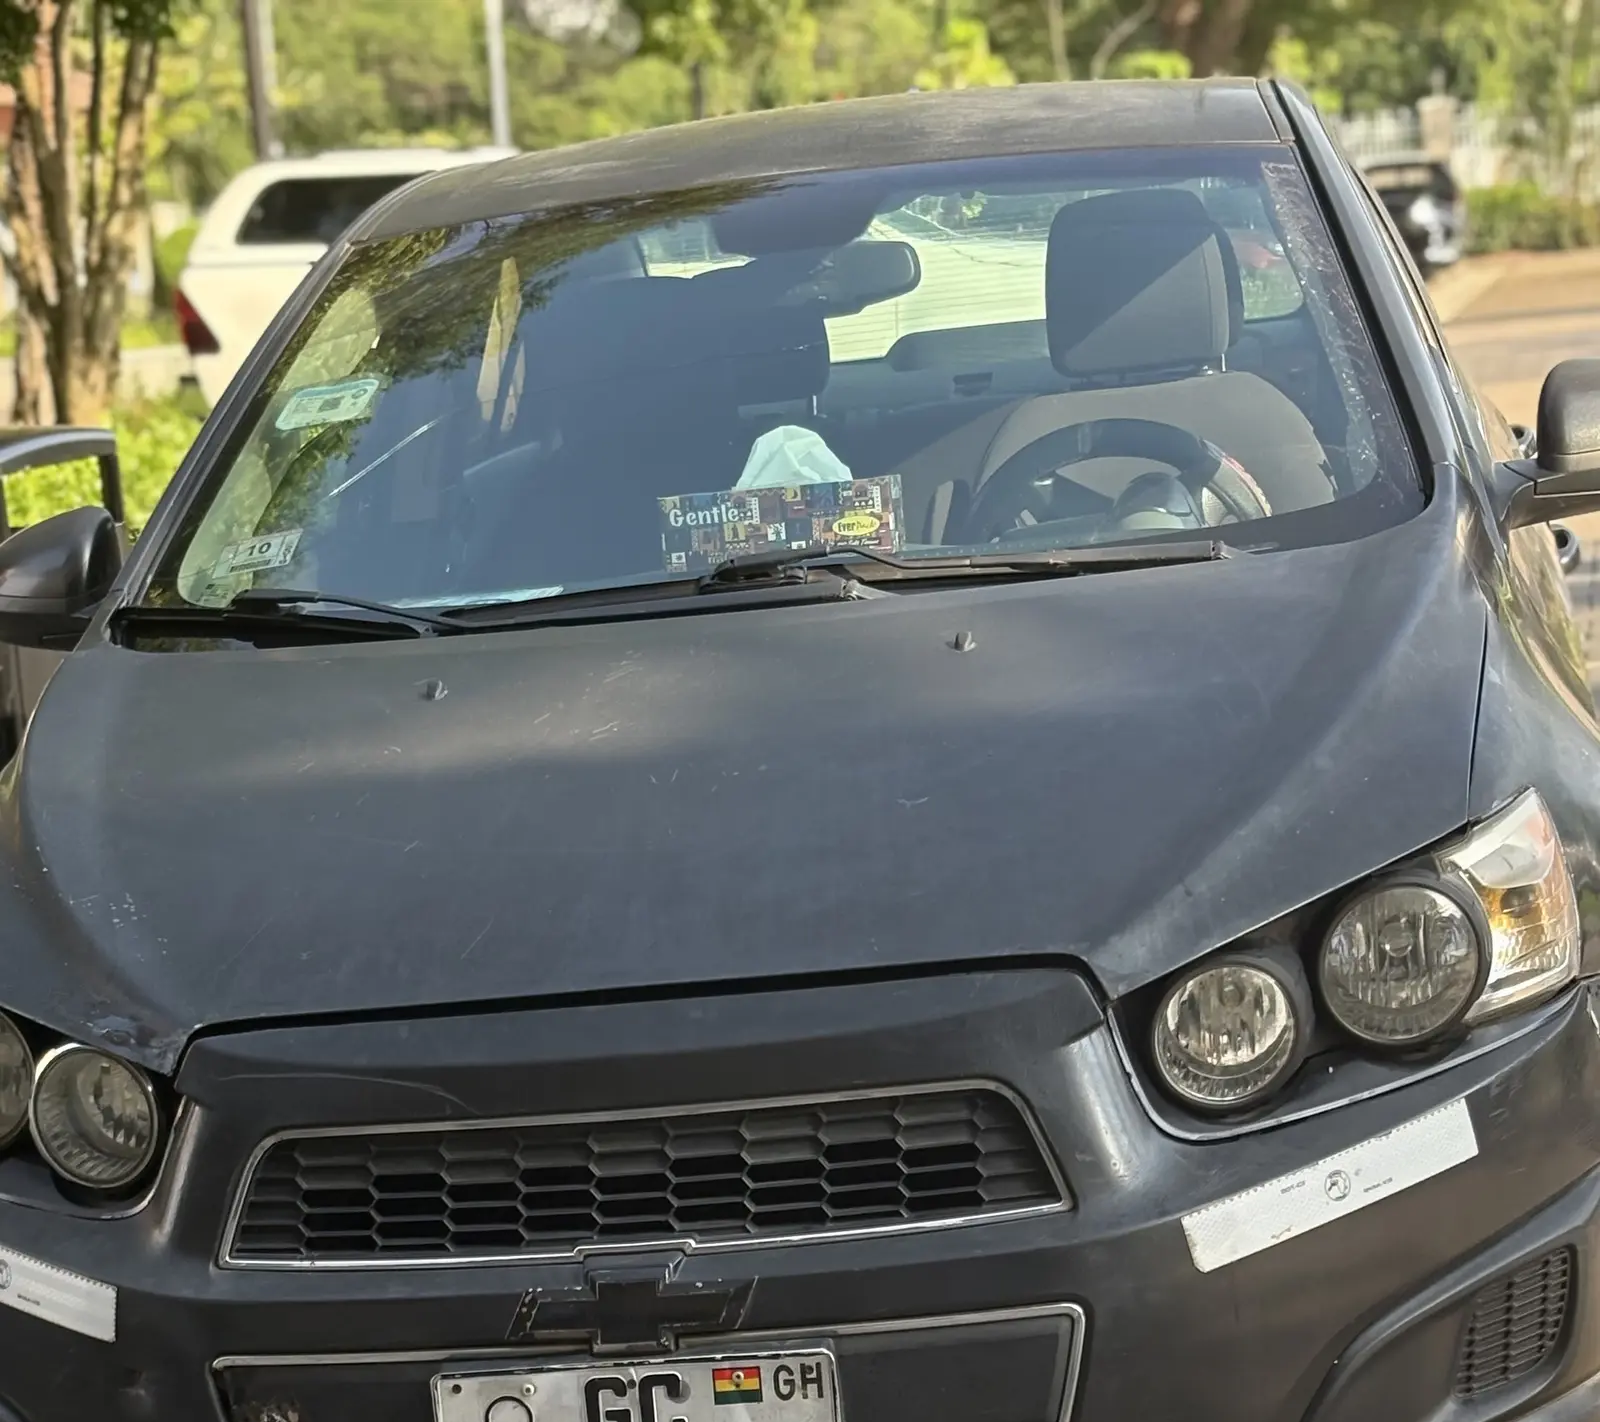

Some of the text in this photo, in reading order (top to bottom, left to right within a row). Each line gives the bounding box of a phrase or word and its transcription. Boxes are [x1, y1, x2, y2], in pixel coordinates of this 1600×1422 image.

[669, 504, 740, 527] Gentle
[248, 542, 272, 556] 10
[773, 1363, 824, 1401] GH
